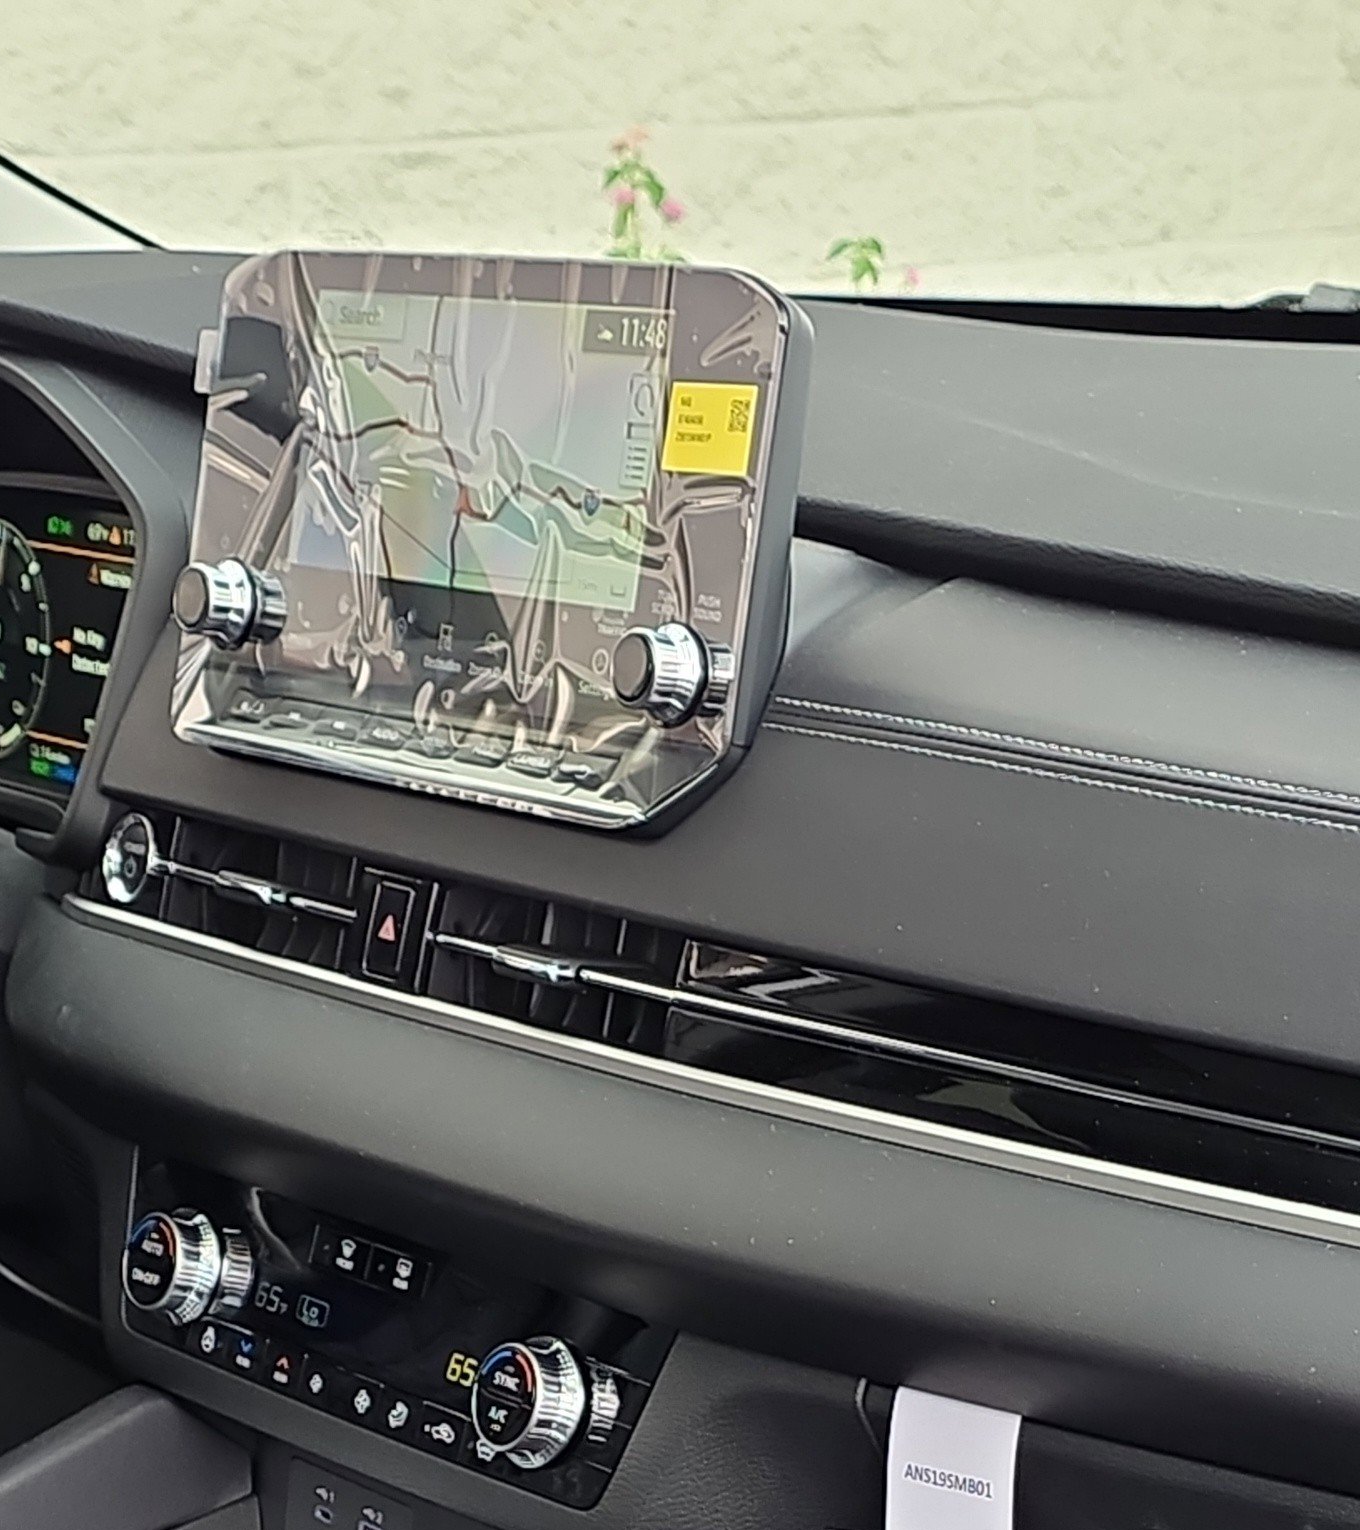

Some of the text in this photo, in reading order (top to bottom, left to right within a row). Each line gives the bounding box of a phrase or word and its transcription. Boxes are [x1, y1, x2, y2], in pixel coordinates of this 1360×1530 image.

[621, 318, 667, 349] 11:48
[446, 1352, 478, 1387] 65
[492, 1371, 520, 1392] SYNC
